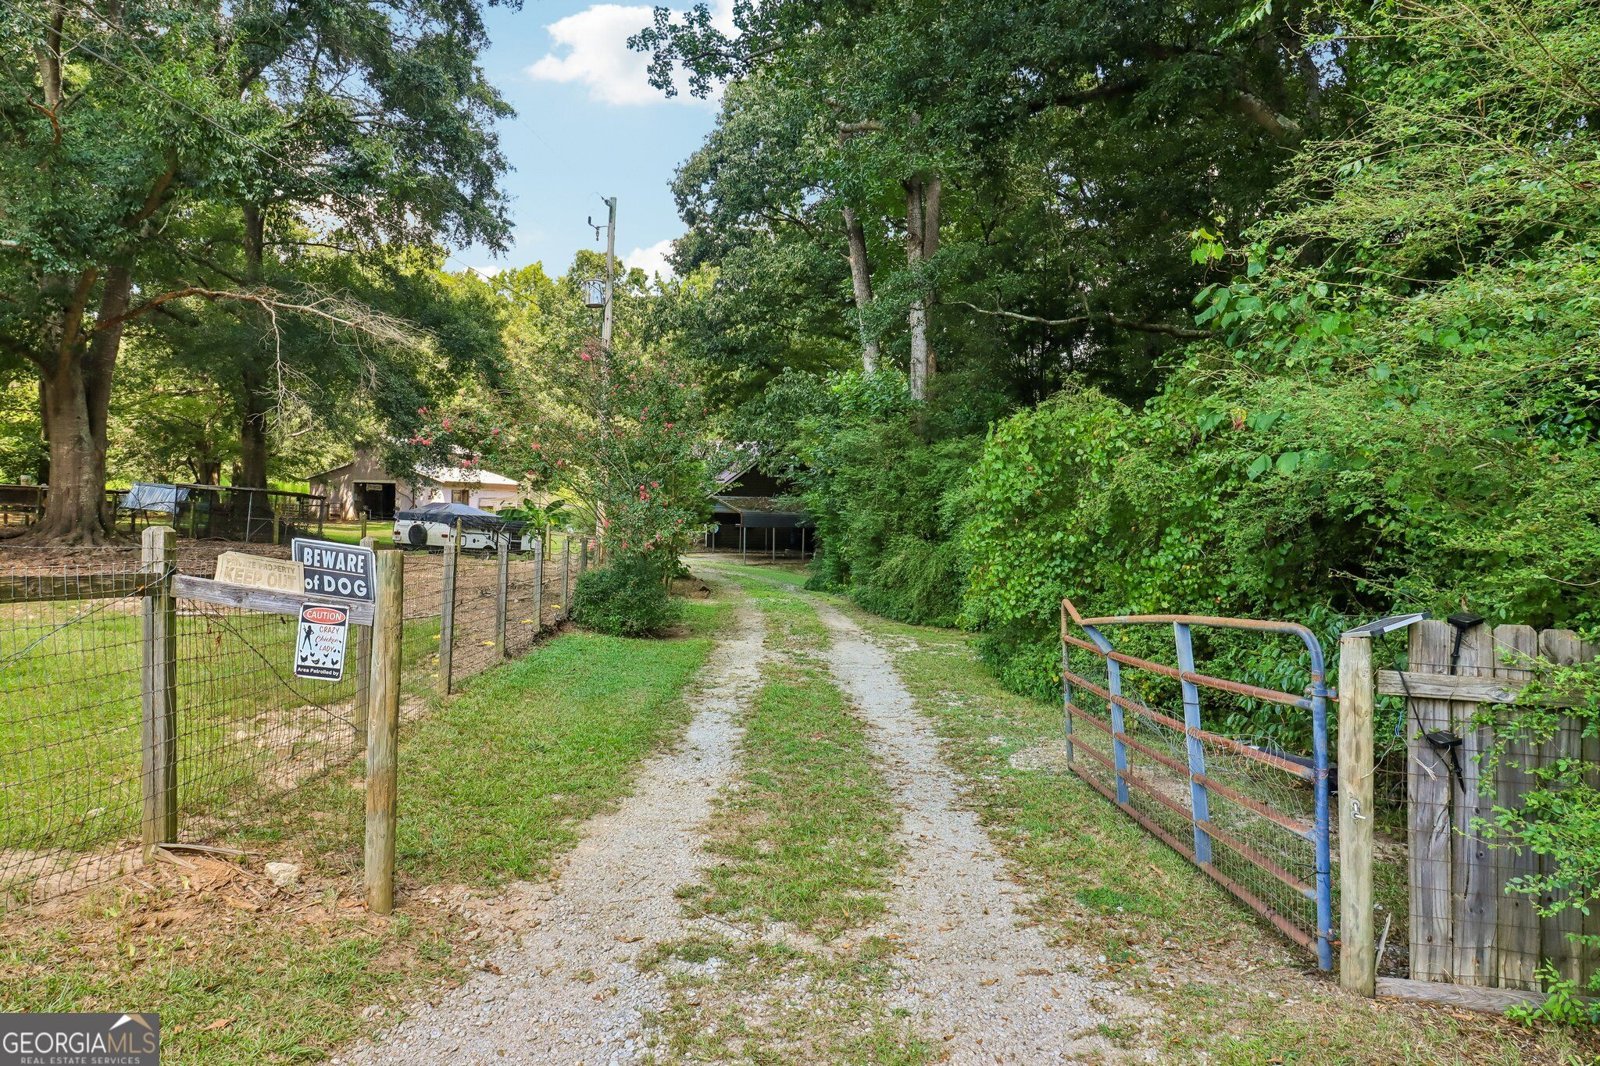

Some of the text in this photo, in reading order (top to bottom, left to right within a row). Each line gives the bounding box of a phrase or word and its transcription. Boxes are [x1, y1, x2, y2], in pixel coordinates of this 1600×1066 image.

[259, 562, 296, 574] PROPERTY
[303, 547, 365, 573] BEWARE
[224, 566, 297, 588] KEEP OUT
[304, 574, 368, 597] of DOG
[306, 610, 342, 621] CAUTION
[319, 625, 340, 634] CRAZY
